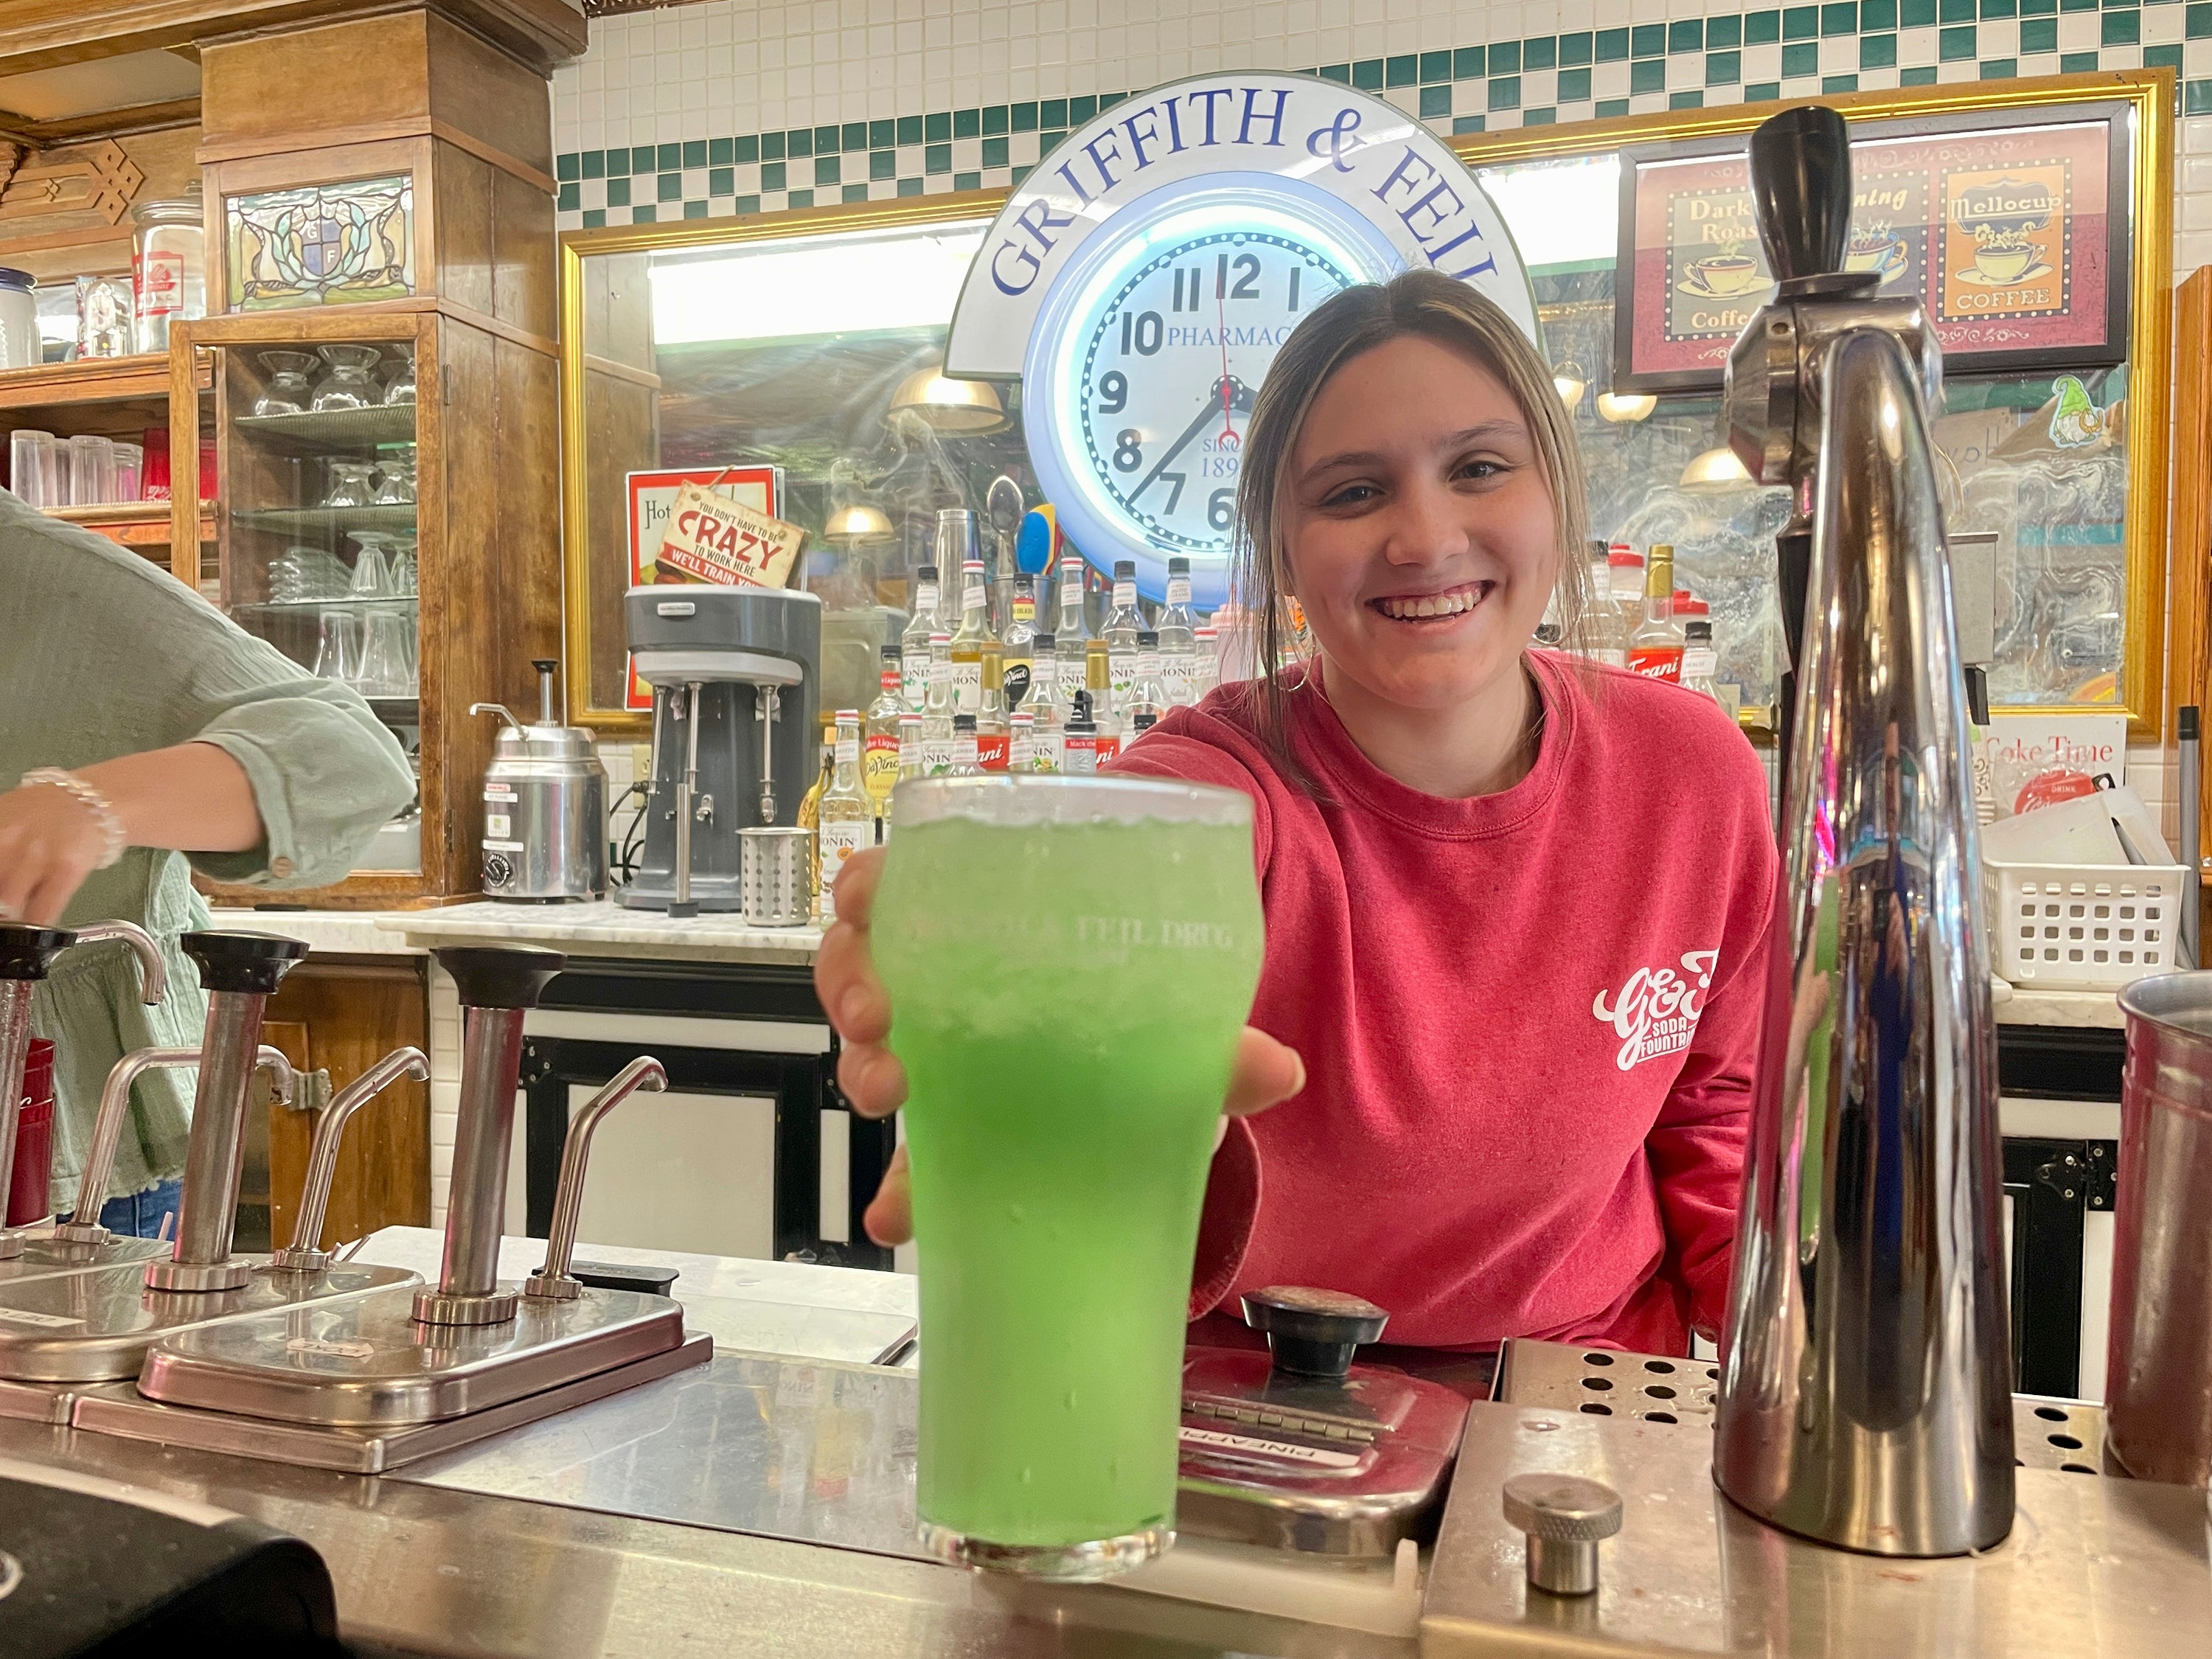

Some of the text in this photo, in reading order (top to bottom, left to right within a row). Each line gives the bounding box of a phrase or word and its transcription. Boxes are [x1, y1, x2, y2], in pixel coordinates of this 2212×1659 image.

[992, 88, 1294, 297] GRIFFITH
[1307, 108, 1367, 173] &
[1853, 187, 1908, 211] ning
[1689, 198, 1753, 220] Dark
[1950, 195, 2063, 220] Mellocup
[1701, 222, 1759, 243] Roas
[327, 249, 335, 263] F
[1216, 253, 1261, 299] 12
[1172, 268, 1200, 312] 11
[1288, 267, 1300, 312] 1
[1956, 288, 2051, 310] COFFEE
[1691, 310, 1749, 329] Coffe
[1121, 310, 1164, 356] 10
[1167, 327, 1291, 347] PHARMAC
[1099, 370, 1127, 414] 9
[1113, 428, 1142, 473] 8
[1203, 438, 1241, 453] SINC
[1201, 457, 1239, 478] 189
[1158, 473, 1186, 515] 7
[645, 500, 672, 530] Hot
[700, 501, 779, 544] YOU DON'T HAVE TO BE
[1207, 487, 1237, 532] 6
[678, 509, 783, 571] CRAZY
[672, 548, 700, 572] WE'LL
[703, 563, 736, 586] TRAIN
[694, 544, 757, 577] TO WORK HERE
[953, 675, 978, 685] MON
[1057, 675, 1086, 684] ONIN
[1160, 668, 1194, 677] MONI
[978, 743, 1003, 762] ani
[2048, 735, 2114, 763] Time
[866, 755, 899, 777] DaVinc
[1652, 1016, 1688, 1037] SODA
[1182, 1429, 1317, 1459] PINEAPP
